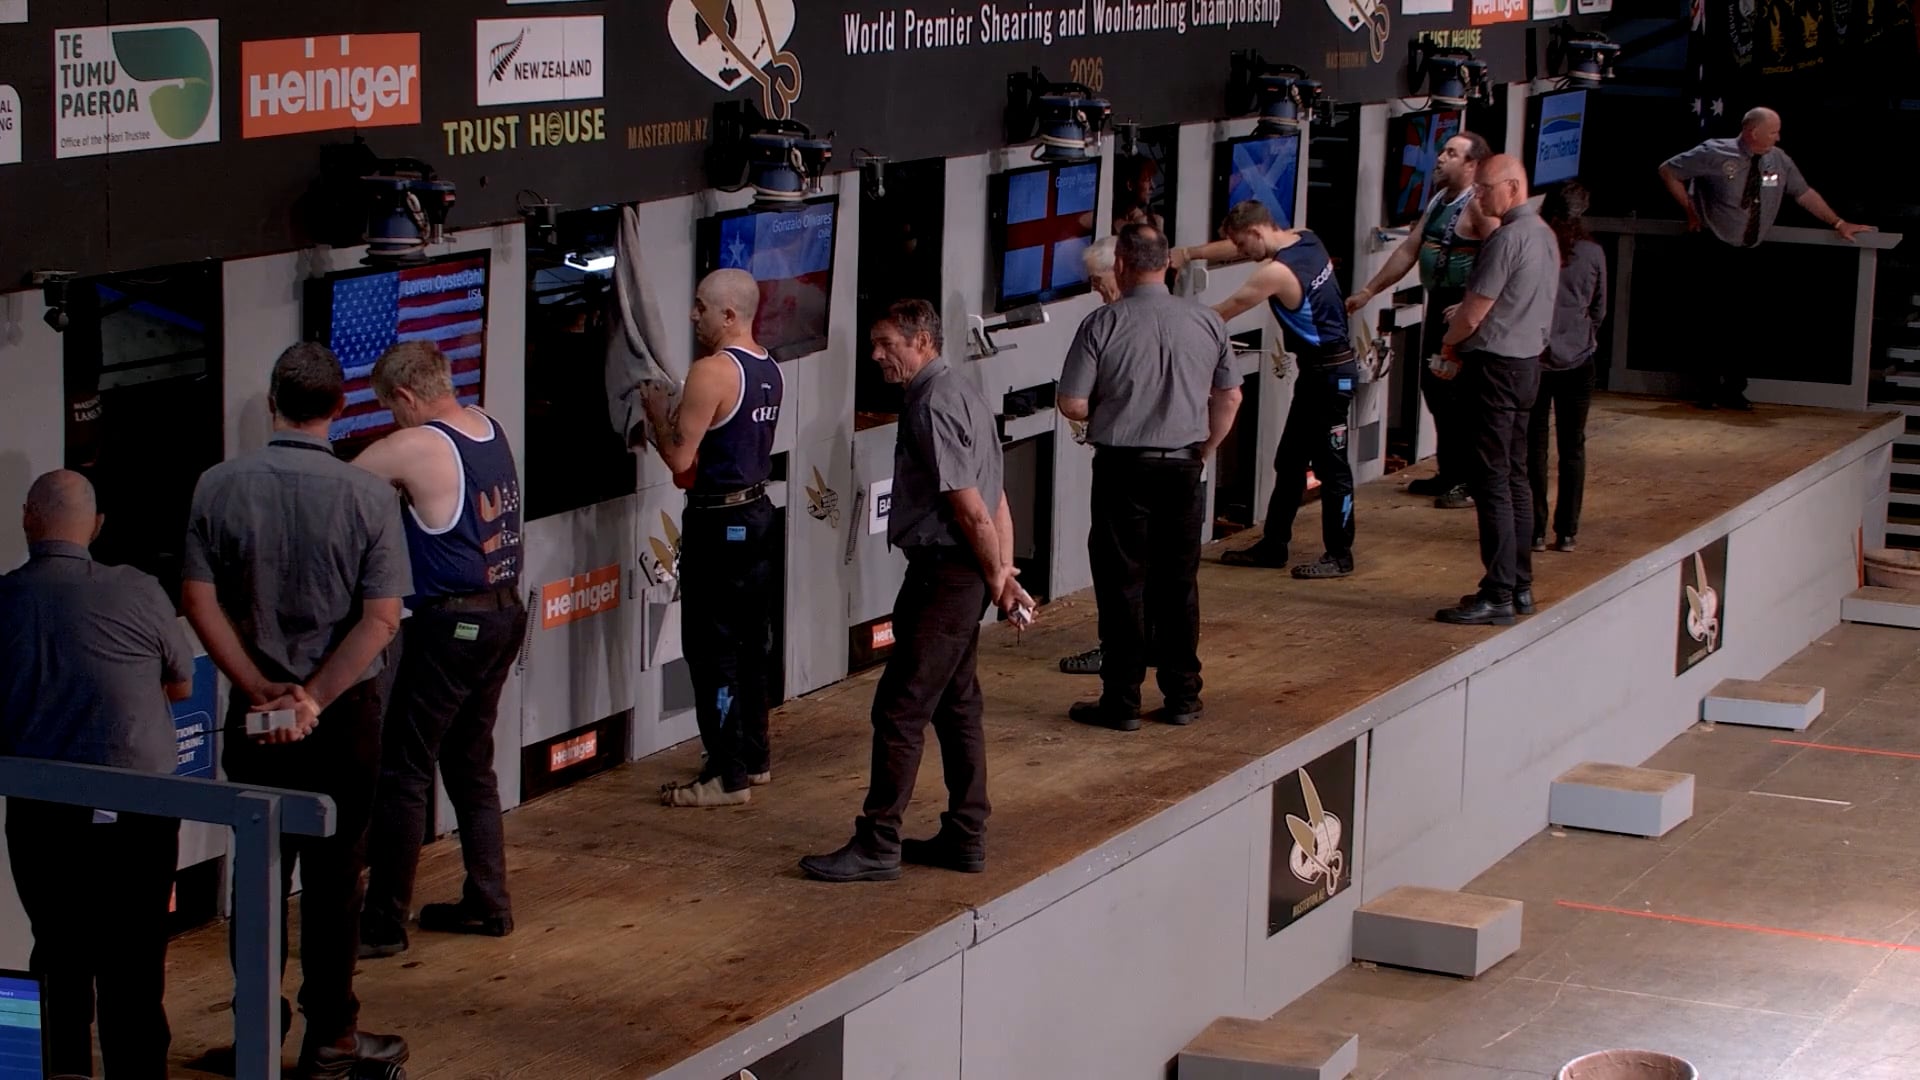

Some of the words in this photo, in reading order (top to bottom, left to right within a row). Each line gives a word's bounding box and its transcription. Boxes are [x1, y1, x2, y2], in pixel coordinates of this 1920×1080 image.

[844, 10, 896, 55] World
[905, 8, 973, 49] Premier
[980, 1, 1052, 46] Shearing
[1059, 0, 1086, 37] and
[1092, 0, 1186, 35] Woolhandling
[1191, 0, 1281, 31] Championship
[60, 34, 82, 59] TE
[60, 60, 116, 88] TUMU
[250, 36, 417, 122] Heiniger
[515, 62, 540, 81] NEW
[542, 59, 592, 78] ZEALAND
[1070, 56, 1103, 92] 2026
[61, 88, 139, 118] PAEROA
[61, 136, 81, 149] Office
[83, 136, 90, 147] of
[91, 135, 102, 145] the
[124, 131, 150, 142] Trustee
[443, 115, 520, 156] TRUST
[529, 108, 606, 147] HOUSE
[627, 118, 709, 150] MASTERTON.NZ
[467, 288, 482, 300] USA
[546, 573, 619, 620] Heiniger
[552, 738, 596, 766] Heiniger
